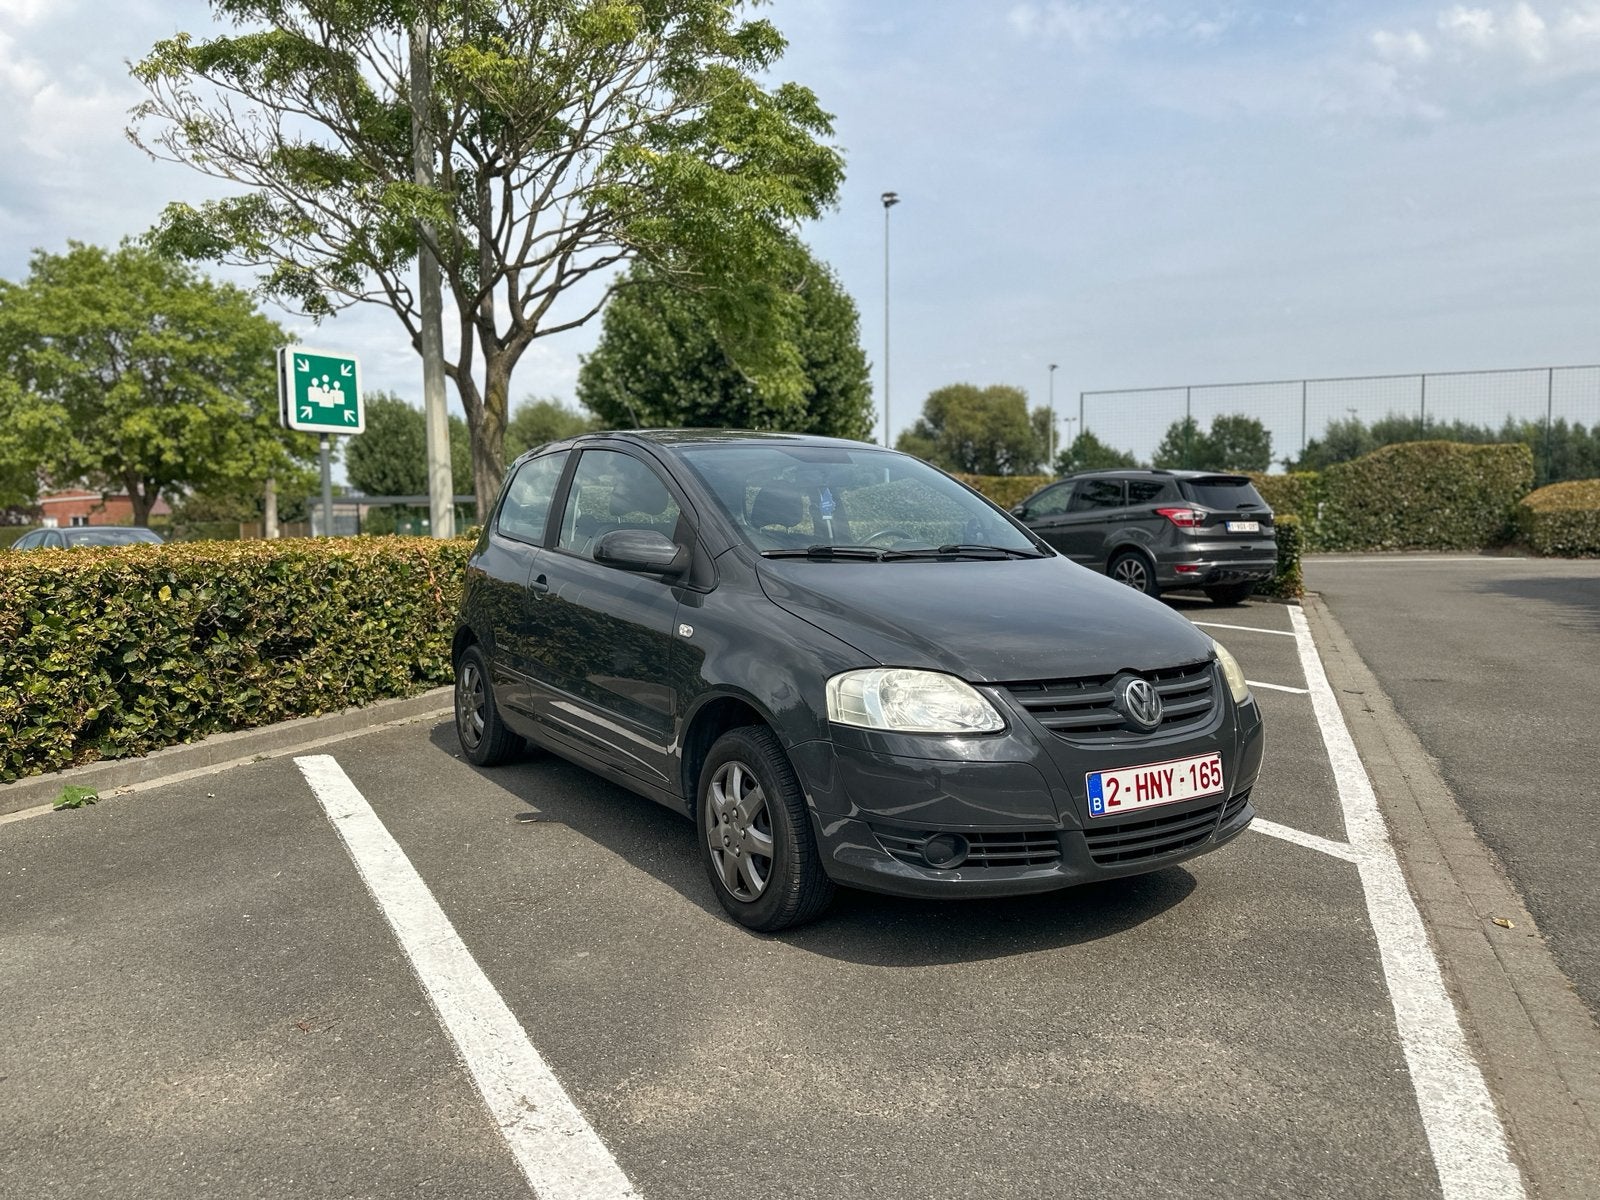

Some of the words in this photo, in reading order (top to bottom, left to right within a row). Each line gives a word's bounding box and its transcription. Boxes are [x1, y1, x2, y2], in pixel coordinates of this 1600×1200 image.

[1126, 680, 1161, 725] VW
[1093, 797, 1102, 811] B
[1106, 759, 1220, 807] 2-HNY-165
